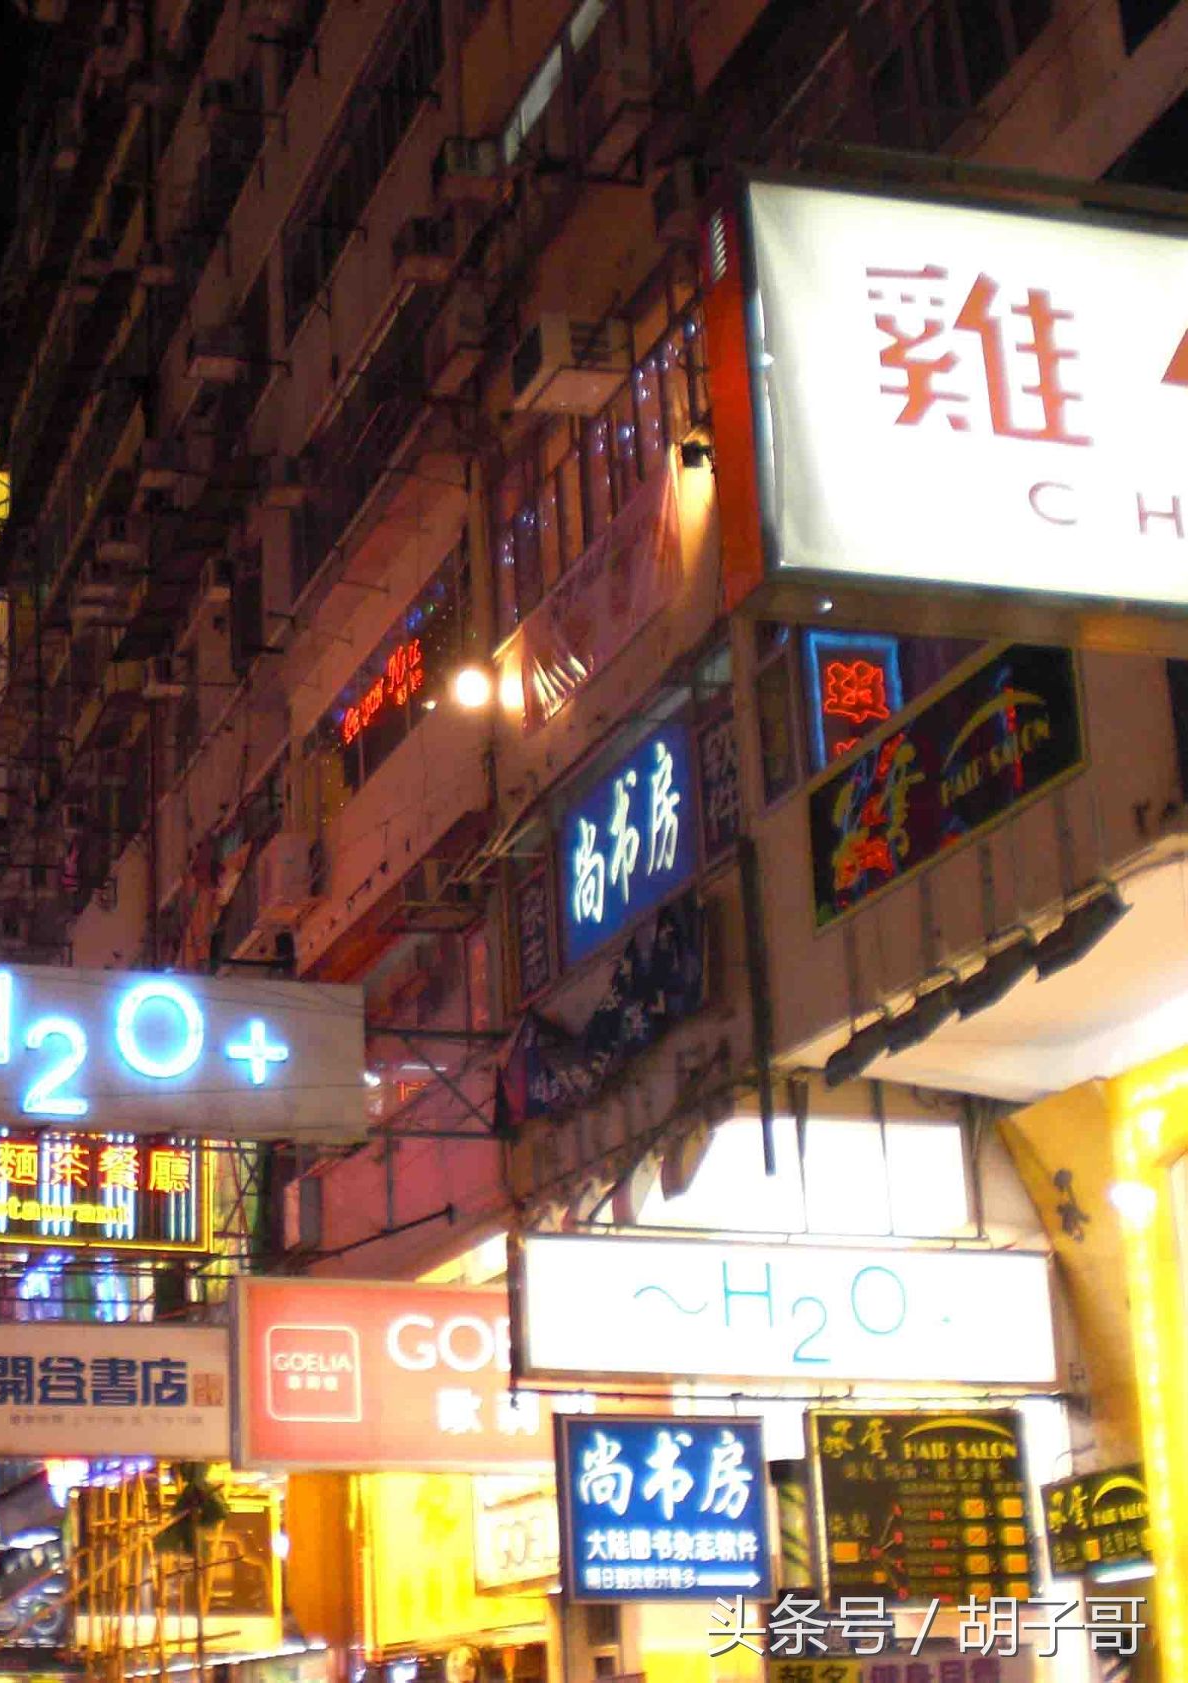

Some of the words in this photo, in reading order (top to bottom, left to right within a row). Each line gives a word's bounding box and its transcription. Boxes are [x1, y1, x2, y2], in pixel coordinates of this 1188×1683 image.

[272, 1351, 353, 1373] GOELIA
[579, 1431, 754, 1521] 尚书房
